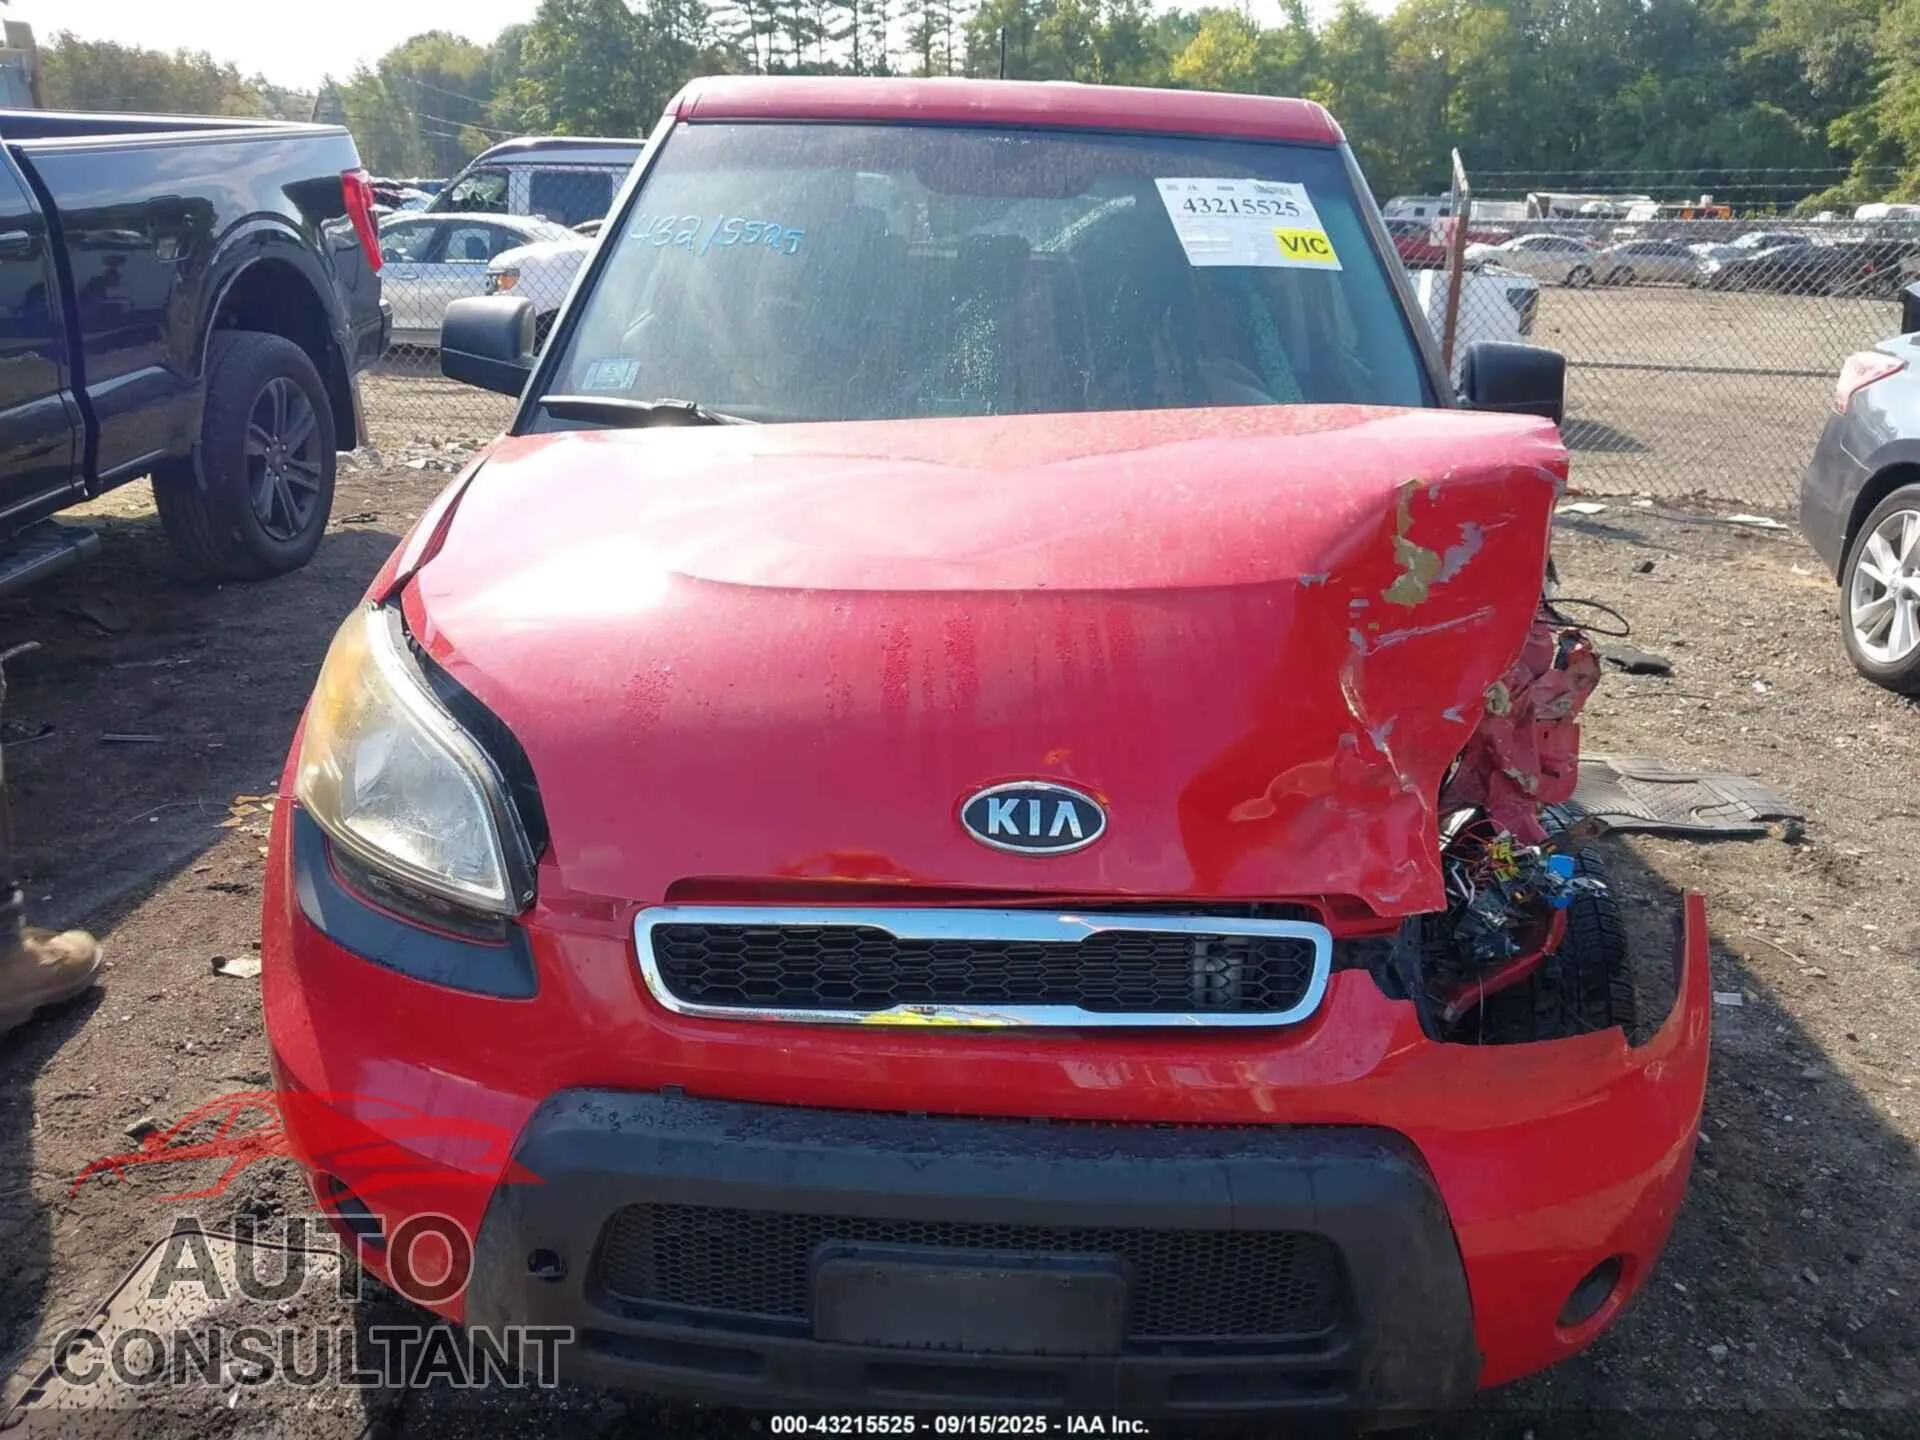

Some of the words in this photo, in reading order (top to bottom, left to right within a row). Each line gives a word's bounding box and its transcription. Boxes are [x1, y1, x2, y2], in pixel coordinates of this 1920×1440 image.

[1182, 197, 1300, 217] 43215525
[1279, 234, 1329, 255] VIC
[987, 798, 1083, 839] KIA
